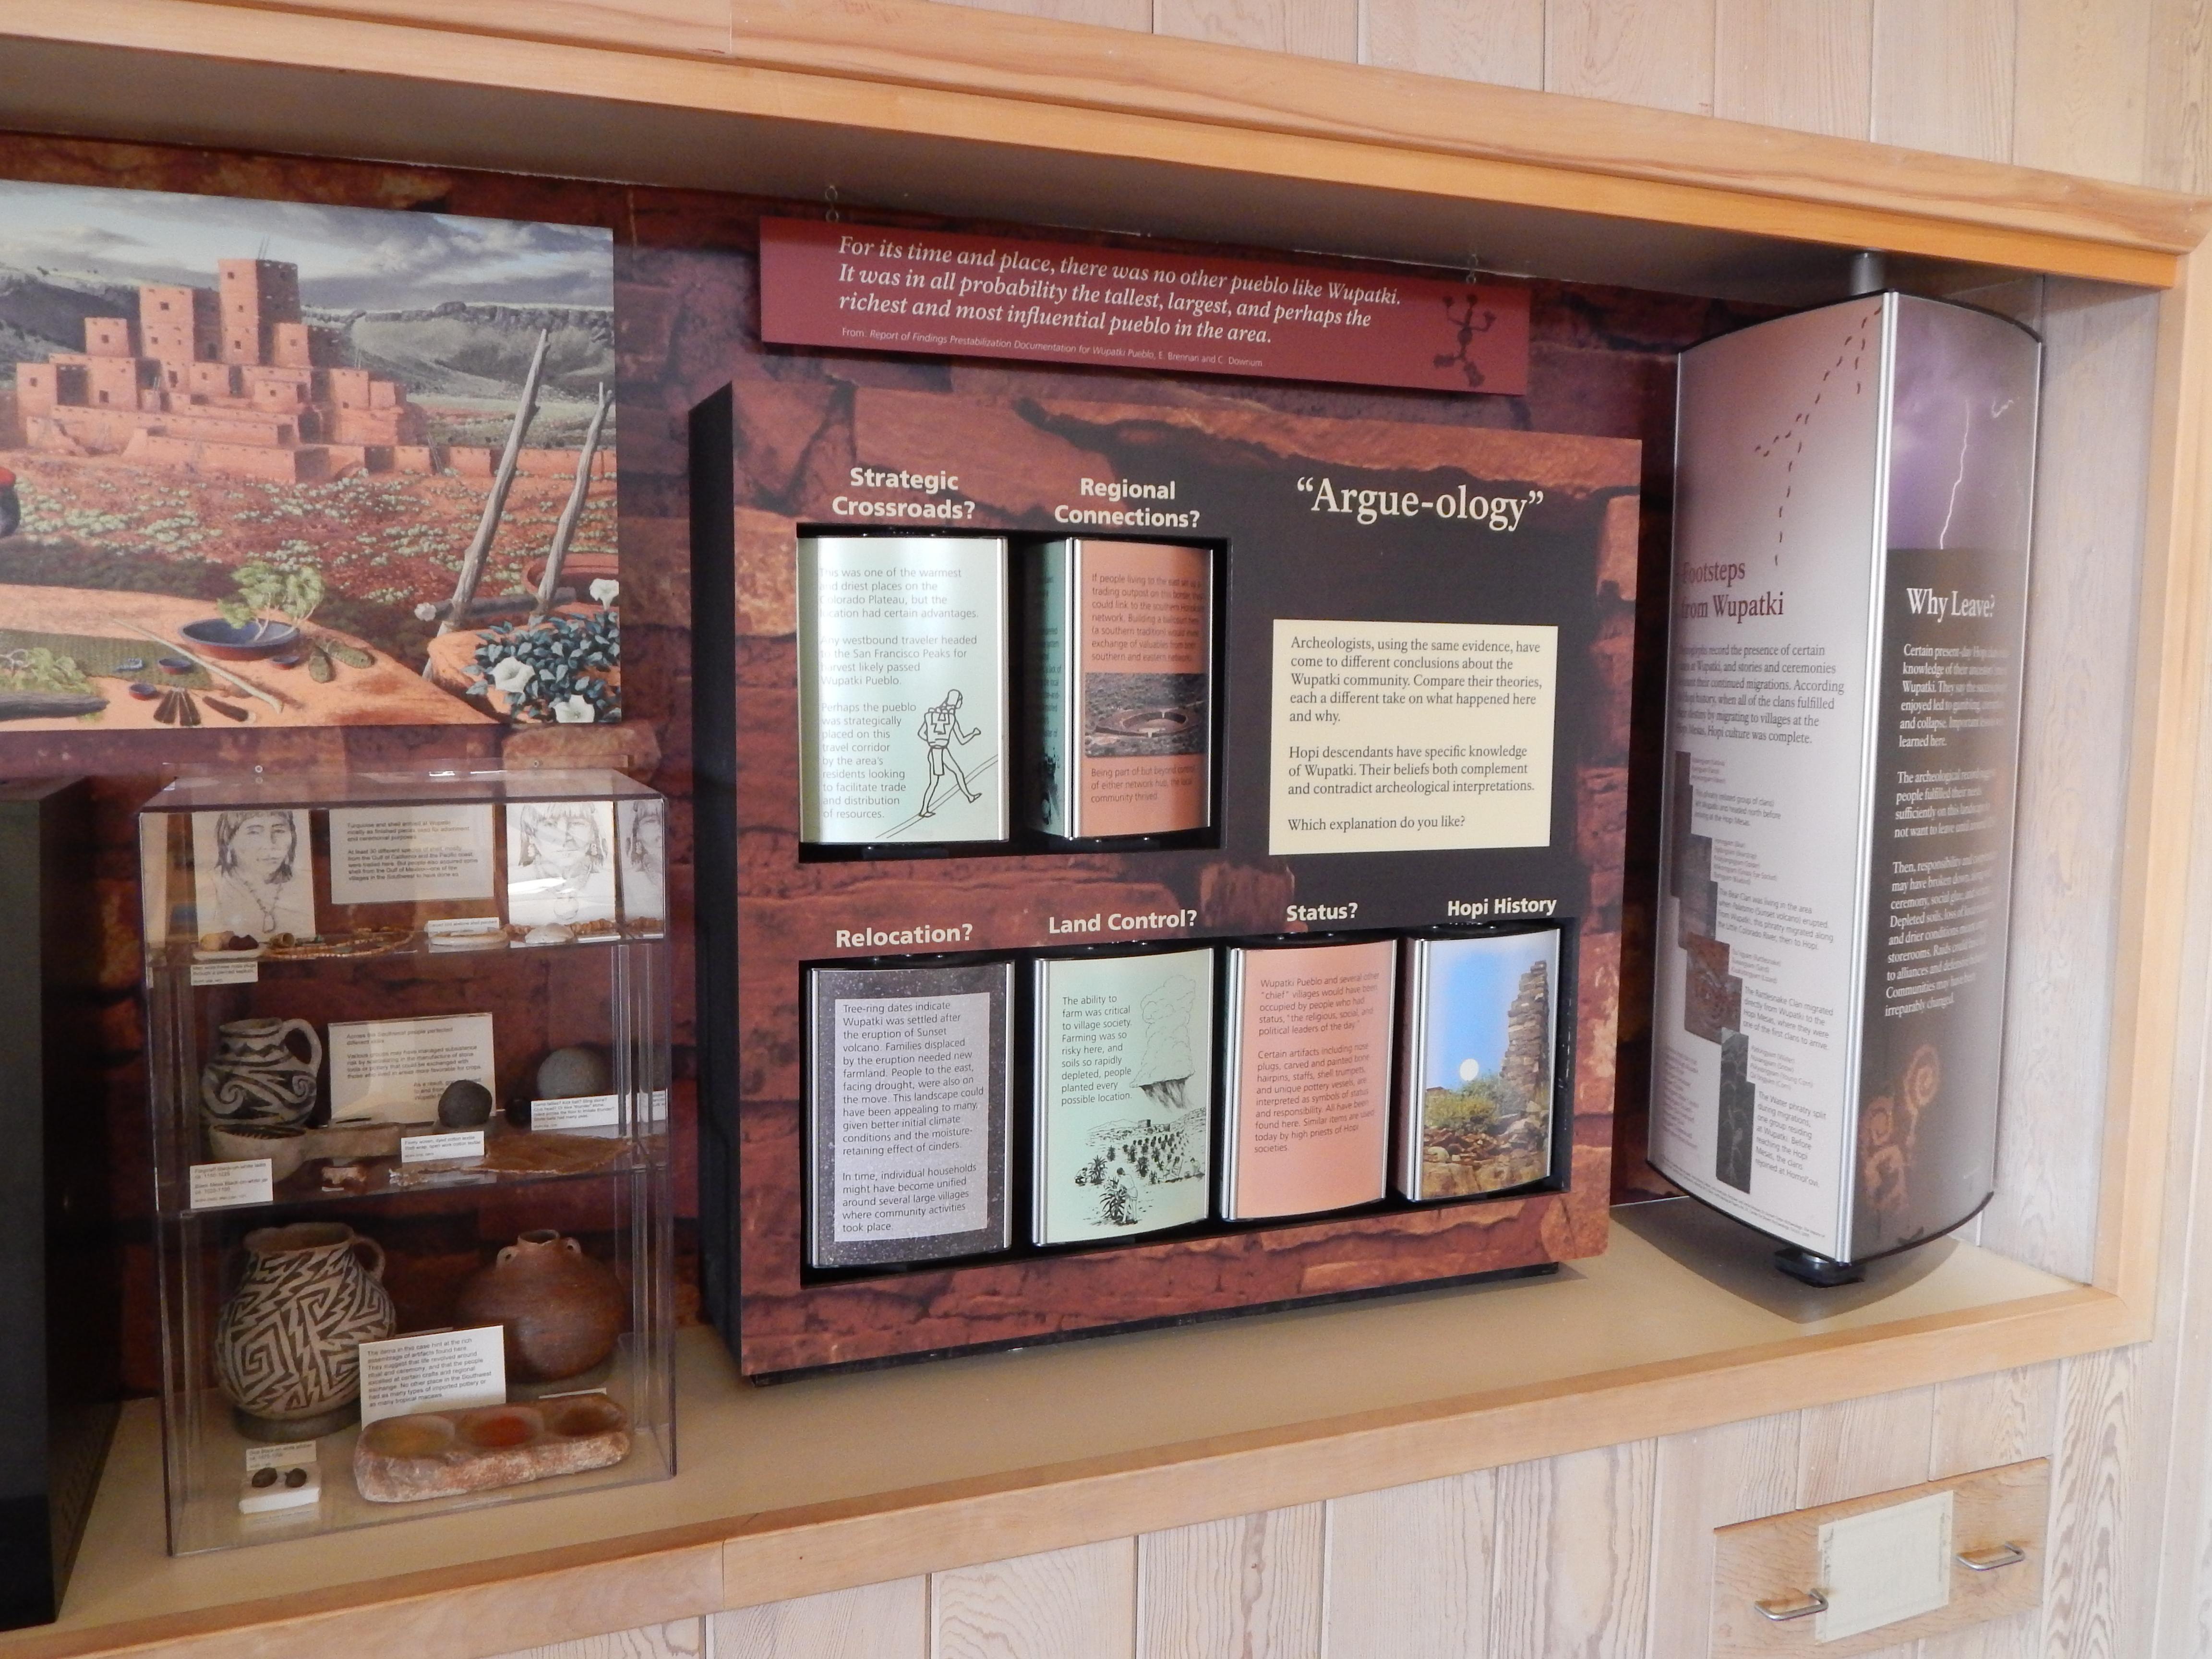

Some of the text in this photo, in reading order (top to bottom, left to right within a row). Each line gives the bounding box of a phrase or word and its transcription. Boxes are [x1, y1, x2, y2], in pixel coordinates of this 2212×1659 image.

[839, 236, 1401, 305] For its time and place, there was no other pueblo like Wupatki.
[839, 264, 1371, 327] It was in all probability the tallest, largest, and perhaps the
[839, 292, 1271, 343] richest and most influential pueblo in the area.
[870, 330, 899, 340] Report
[901, 332, 911, 340] of
[912, 333, 948, 345] Findings
[950, 335, 1011, 348] Prestabilization
[1014, 340, 1076, 352] Documentation
[1093, 347, 1125, 356] Wupatki
[1128, 349, 1155, 360] Pueblo,
[1168, 352, 1199, 361] Brennan
[1229, 357, 1262, 366] Downum
[850, 469, 959, 496] Strategic
[1081, 479, 1176, 503] Regional
[832, 496, 976, 522] Crossroads?
[1054, 506, 1201, 529] Connections?
[1713, 591, 1784, 624] Wupatki
[1906, 588, 1995, 623] Why Leave?
[1291, 637, 1540, 653] Archeologists, using the same evidence, have
[1743, 644, 1825, 658] presence of certain
[1291, 656, 1513, 670] come to different conclusions about the
[1291, 673, 1542, 689] Wupatki community. Compare their theories,
[1290, 692, 1537, 707] each a different take on what happened here
[1289, 709, 1340, 725] and why.
[1899, 735, 1928, 747] learned
[1289, 745, 1527, 760] Hopi descendants have specific knowledge
[823, 769, 905, 780] residents looking
[1288, 763, 1528, 780] of Wupatki. Their beliefs both complement
[823, 783, 832, 792] to
[836, 783, 877, 792] facilitate
[1288, 781, 1535, 796] and contradict archeological interpretations.
[844, 796, 900, 805] distribution
[1091, 793, 1133, 803] community
[1288, 815, 1465, 832] Which explanation do you like?
[1286, 903, 1358, 921] Status?
[1447, 898, 1556, 919] Hopi History
[1049, 910, 1198, 934] Land Control?
[836, 924, 973, 948] Relocation?
[843, 1001, 950, 1014] Tree-ring dates indicate
[1081, 995, 1106, 1005] ability
[1105, 1006, 1130, 1015] critical
[843, 1017, 883, 1027] Wupatki
[907, 1014, 937, 1023] settled
[940, 1013, 961, 1022] after
[1074, 1021, 1100, 1031] village
[862, 1031, 901, 1040] eruption
[904, 1028, 914, 1037] of
[917, 1028, 947, 1037] Sunset
[1255, 1133, 1277, 1142] today
[1291, 1130, 1308, 1140] high
[1310, 1129, 1333, 1139] priests
